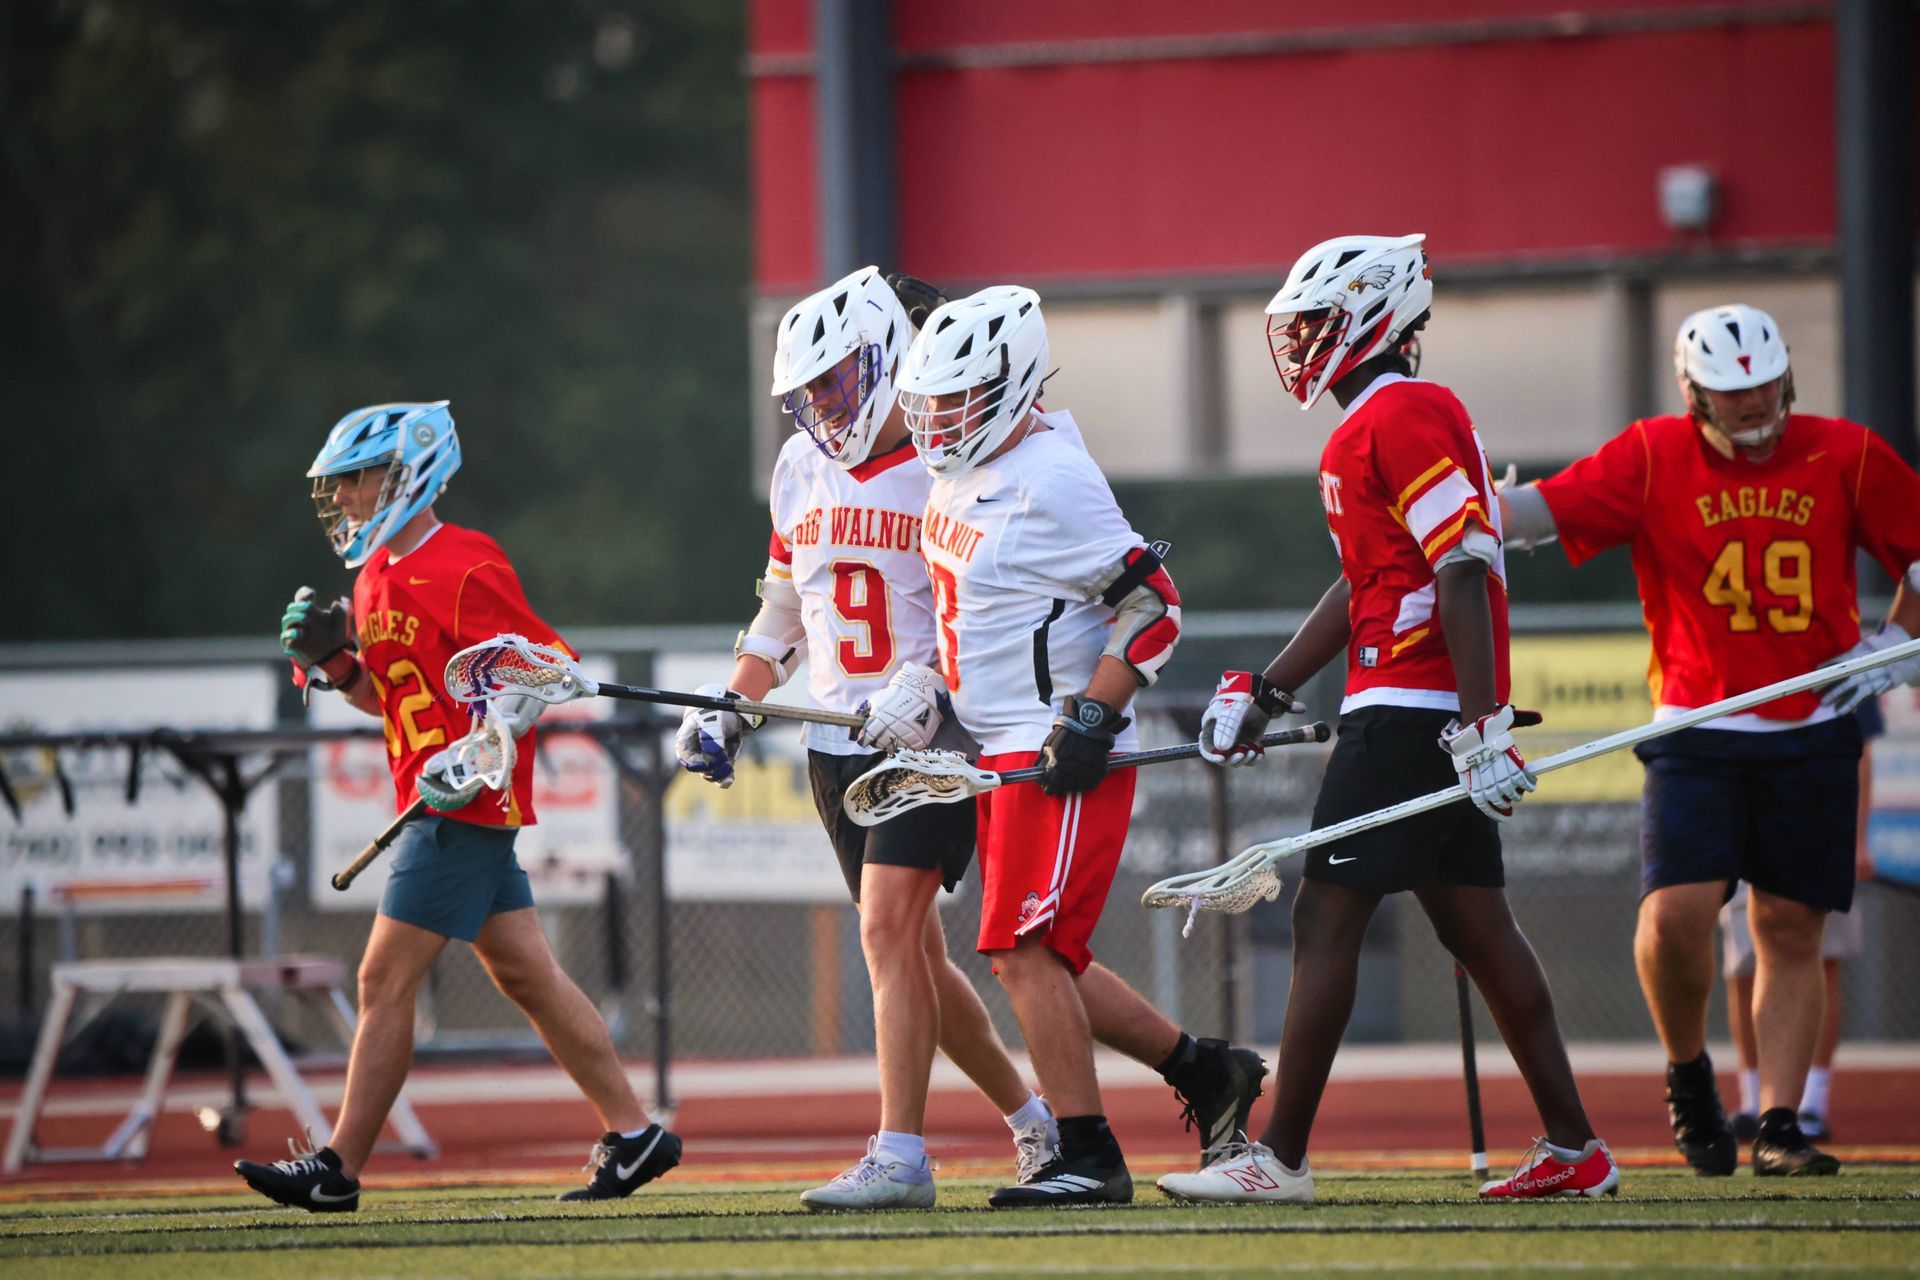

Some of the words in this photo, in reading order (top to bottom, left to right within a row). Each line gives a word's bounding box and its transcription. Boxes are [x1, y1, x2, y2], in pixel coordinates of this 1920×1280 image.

[1695, 486, 1816, 528] EAGLES
[829, 557, 897, 678] 9
[1702, 540, 1815, 634] 49
[1536, 1165, 1577, 1189] balance
